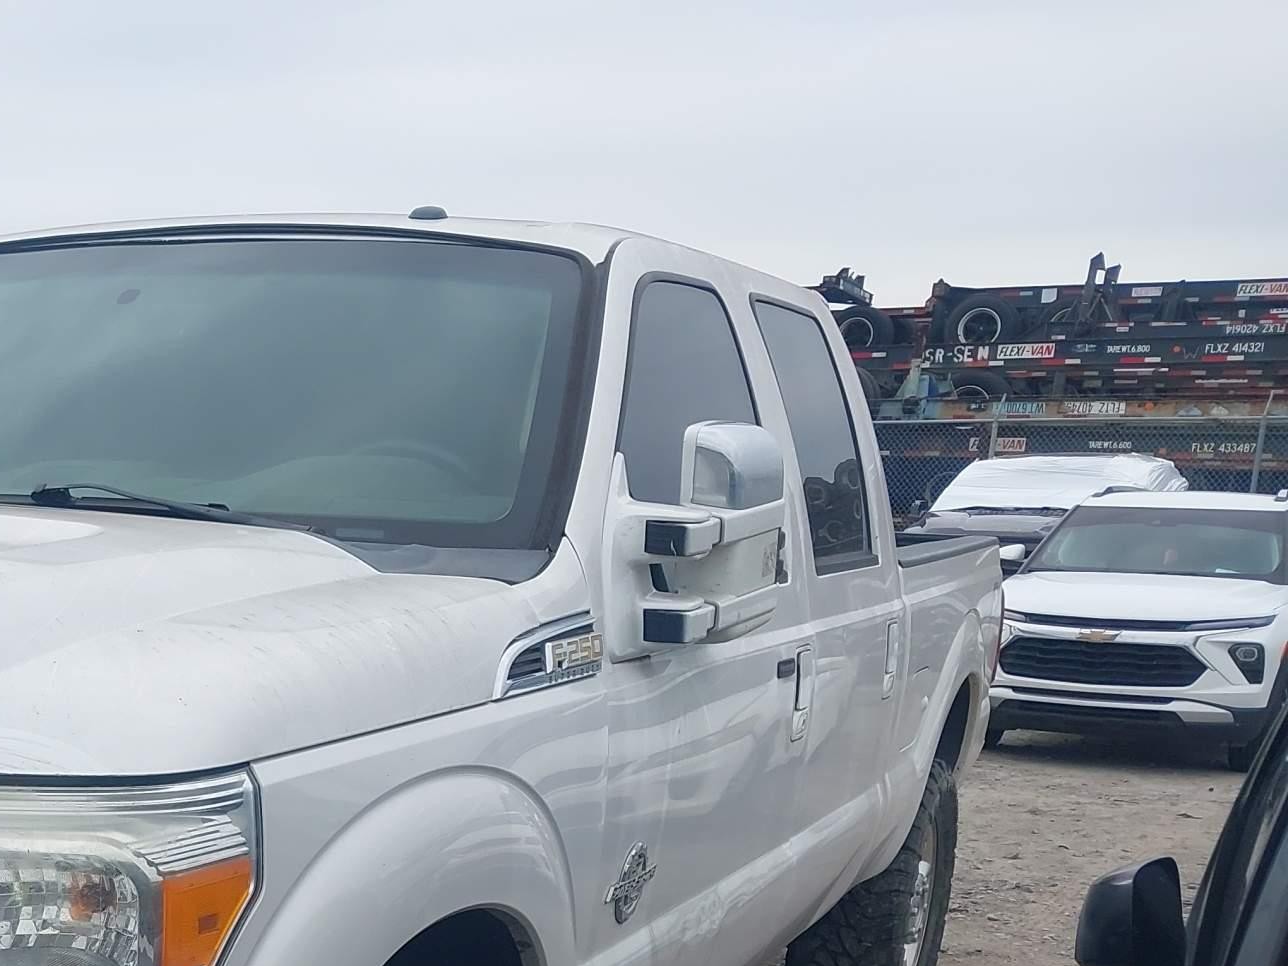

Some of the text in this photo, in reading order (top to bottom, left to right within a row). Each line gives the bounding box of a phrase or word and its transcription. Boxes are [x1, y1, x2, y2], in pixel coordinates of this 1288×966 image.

[998, 344, 1053, 358] FLEXI-VAN
[1204, 342, 1265, 354] FLXZ 414321
[1191, 442, 1214, 453] FLXZ
